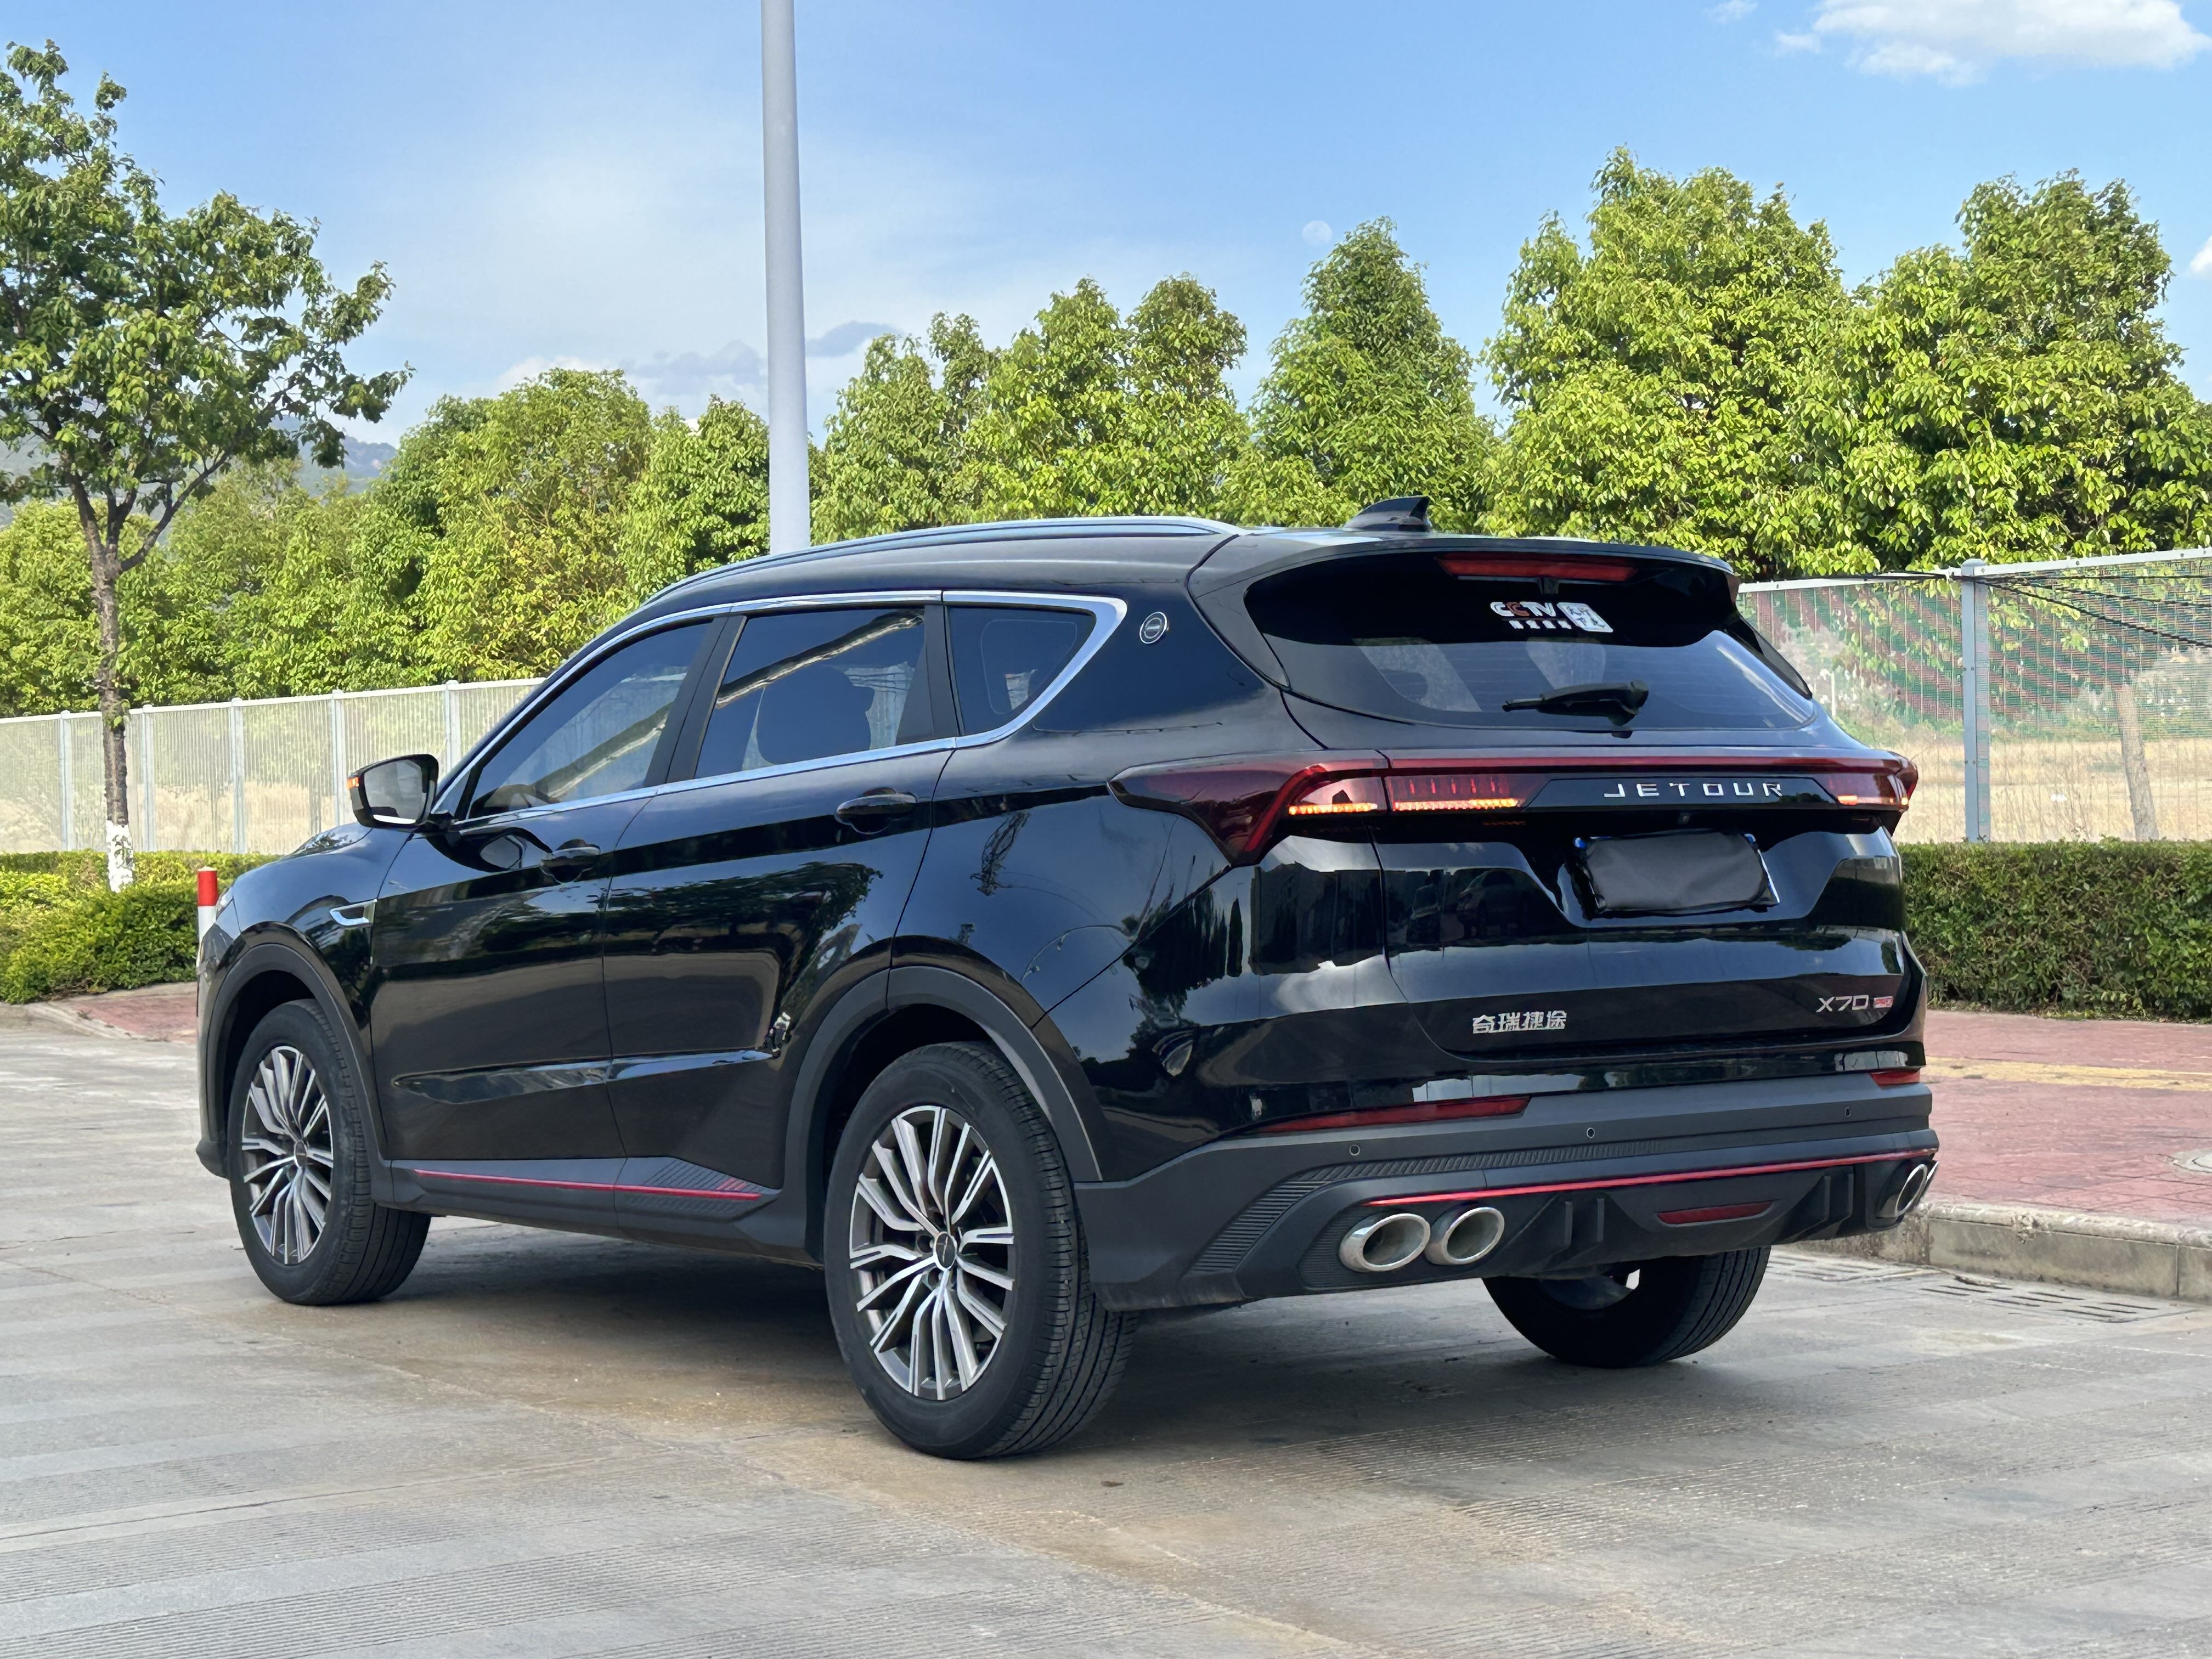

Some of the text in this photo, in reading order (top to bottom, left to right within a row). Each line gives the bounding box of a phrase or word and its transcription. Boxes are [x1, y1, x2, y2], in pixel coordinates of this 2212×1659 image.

[1490, 601, 1556, 617] CCTV
[1604, 782, 1783, 798] JETOUR
[1815, 995, 1869, 1013] X70
[1472, 1010, 1567, 1034] 奇瑞捷途
